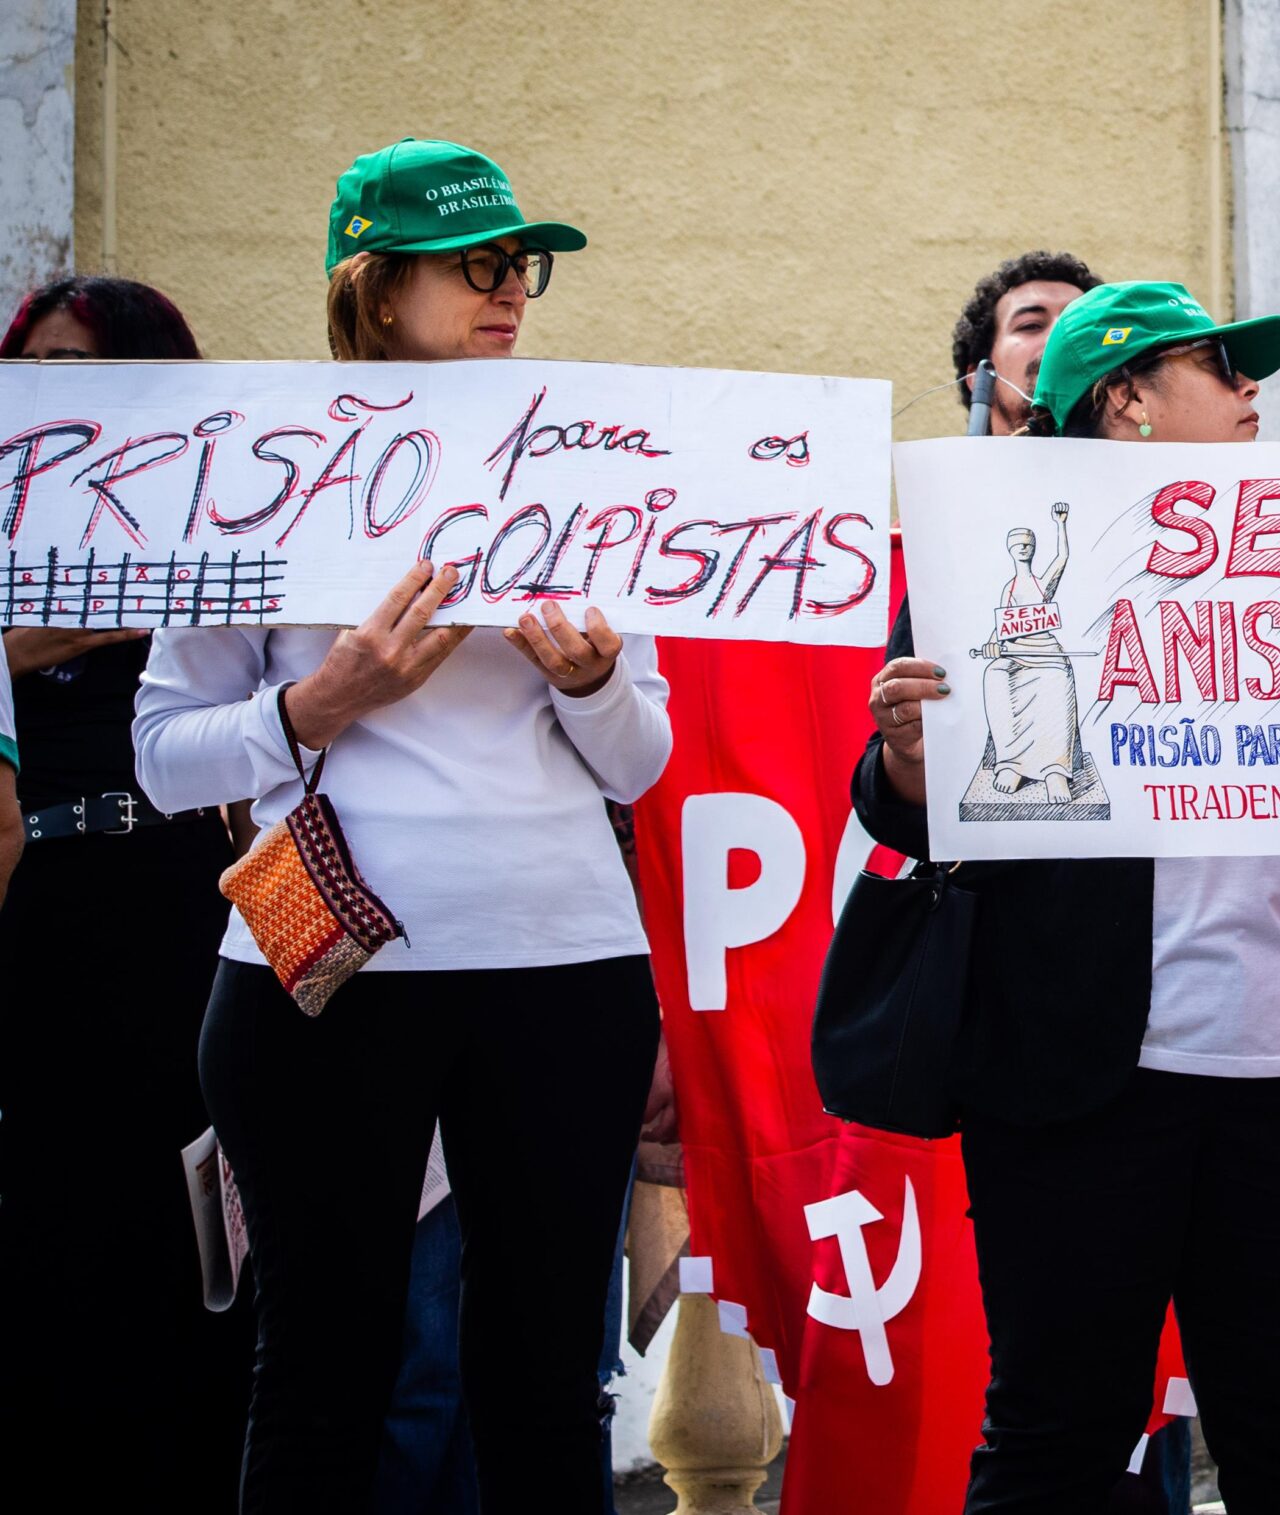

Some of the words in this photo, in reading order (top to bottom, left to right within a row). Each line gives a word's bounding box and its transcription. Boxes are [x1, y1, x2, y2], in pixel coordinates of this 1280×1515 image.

[425, 189, 438, 200] O
[440, 177, 492, 197] BRASIL
[489, 385, 673, 500] para
[748, 431, 810, 468] os
[1000, 613, 1060, 636] ANISTIA!
[1003, 606, 1046, 621] SEM
[1110, 718, 1221, 768] PRISÃO
